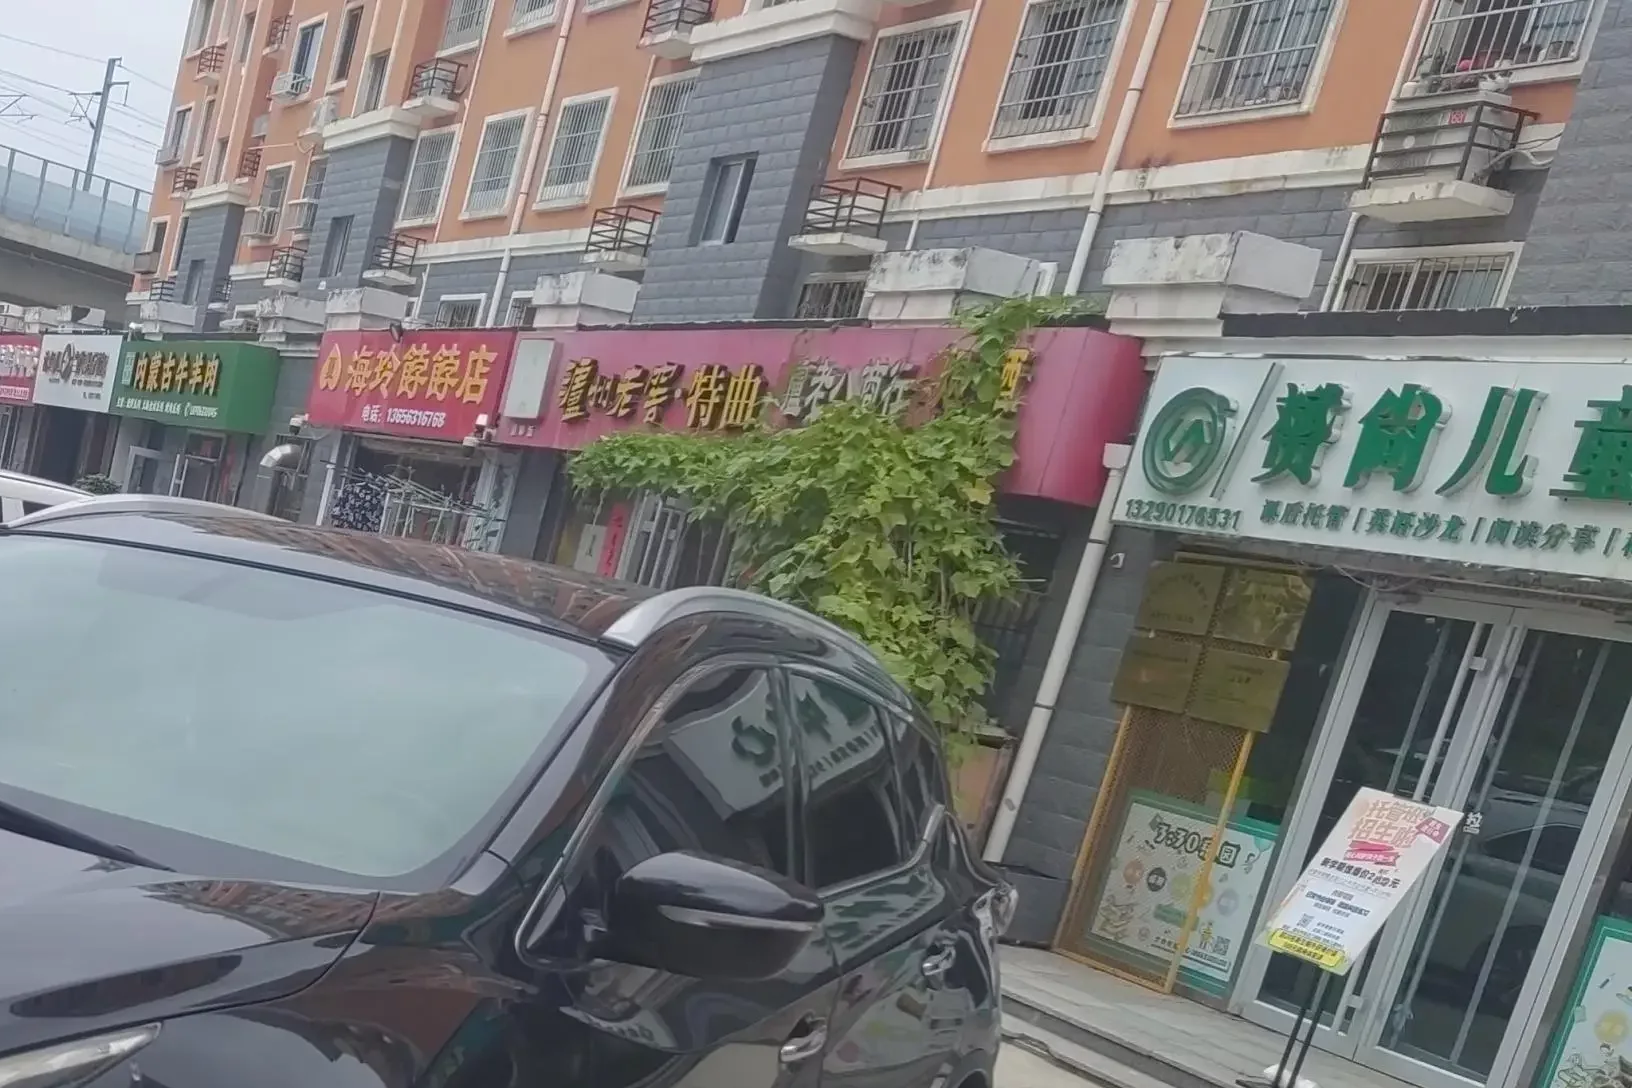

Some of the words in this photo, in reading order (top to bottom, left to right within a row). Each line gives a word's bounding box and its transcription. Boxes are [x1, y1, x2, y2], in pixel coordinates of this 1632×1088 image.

[133, 351, 220, 396] 内蒙古牛羊肉
